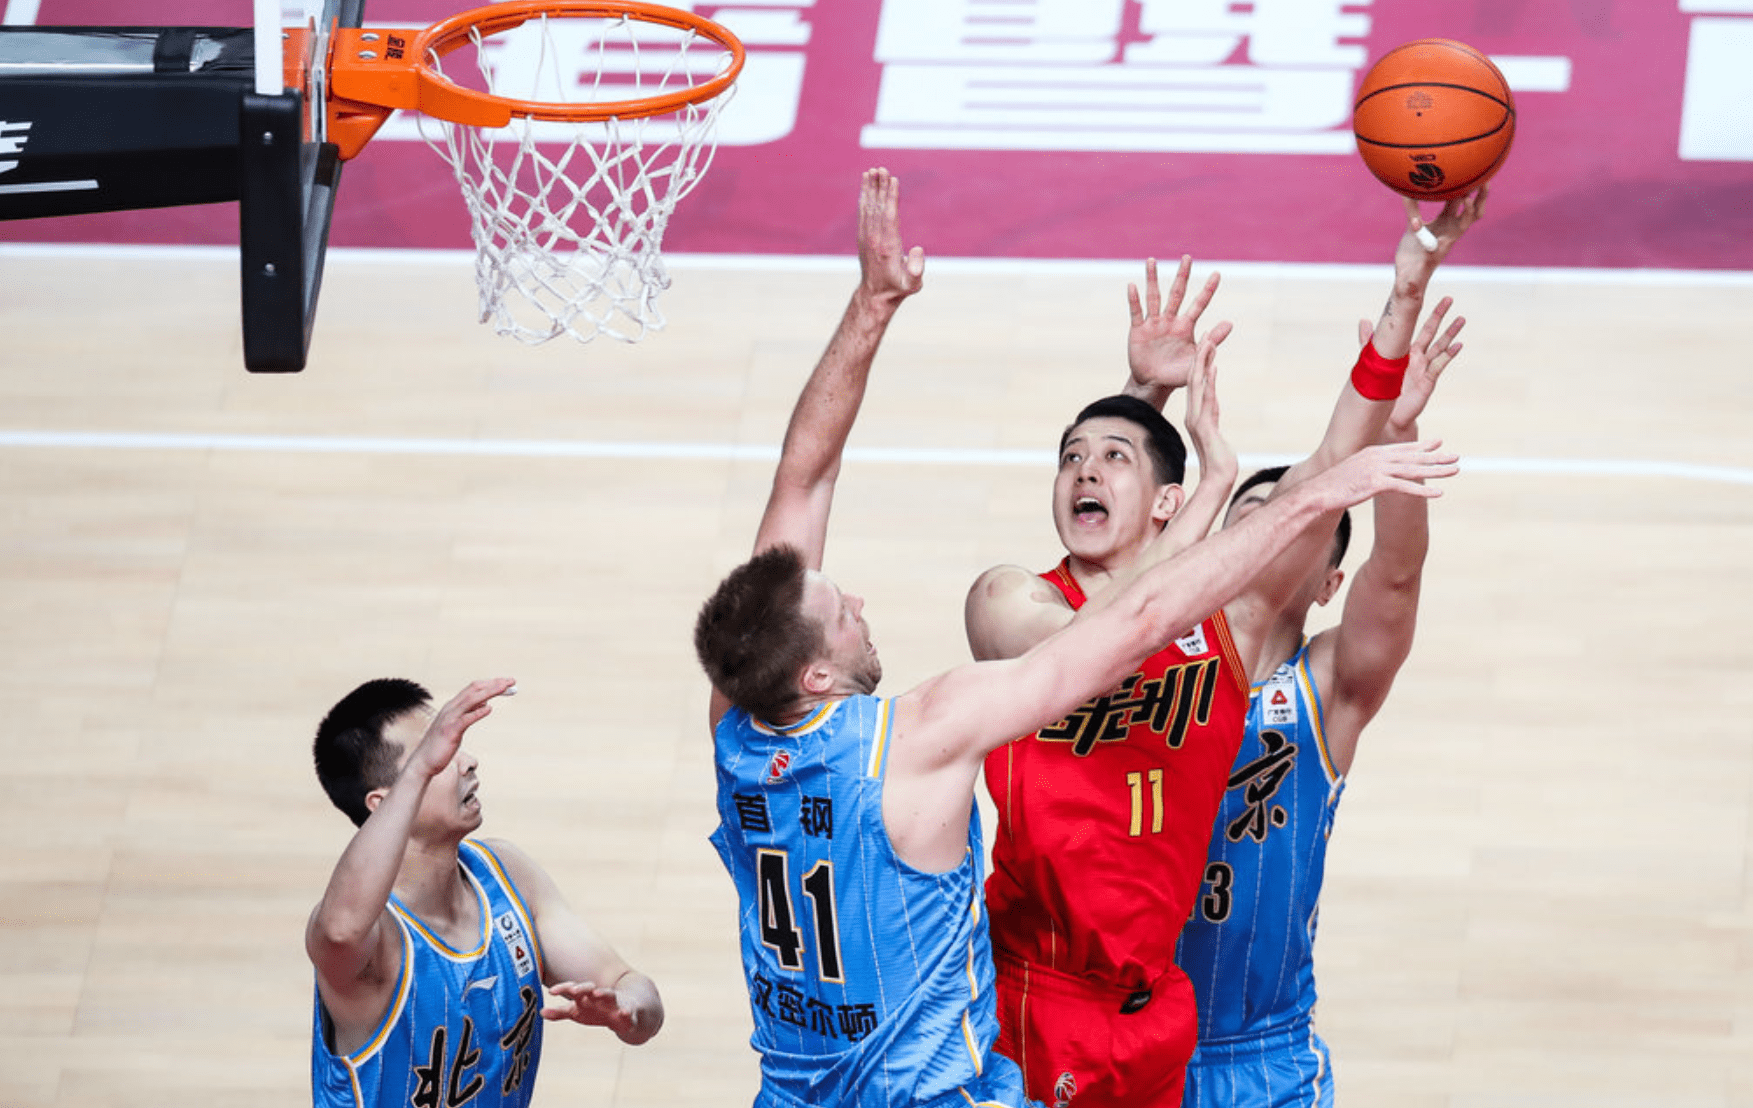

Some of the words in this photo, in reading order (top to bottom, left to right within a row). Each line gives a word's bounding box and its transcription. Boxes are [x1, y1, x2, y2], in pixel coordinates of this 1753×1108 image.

[732, 792, 833, 840] 首钢
[1126, 768, 1164, 837] 11
[1226, 728, 1298, 843] 京
[756, 848, 845, 984] 41
[1188, 861, 1233, 923] 3
[410, 985, 537, 1108] 北京
